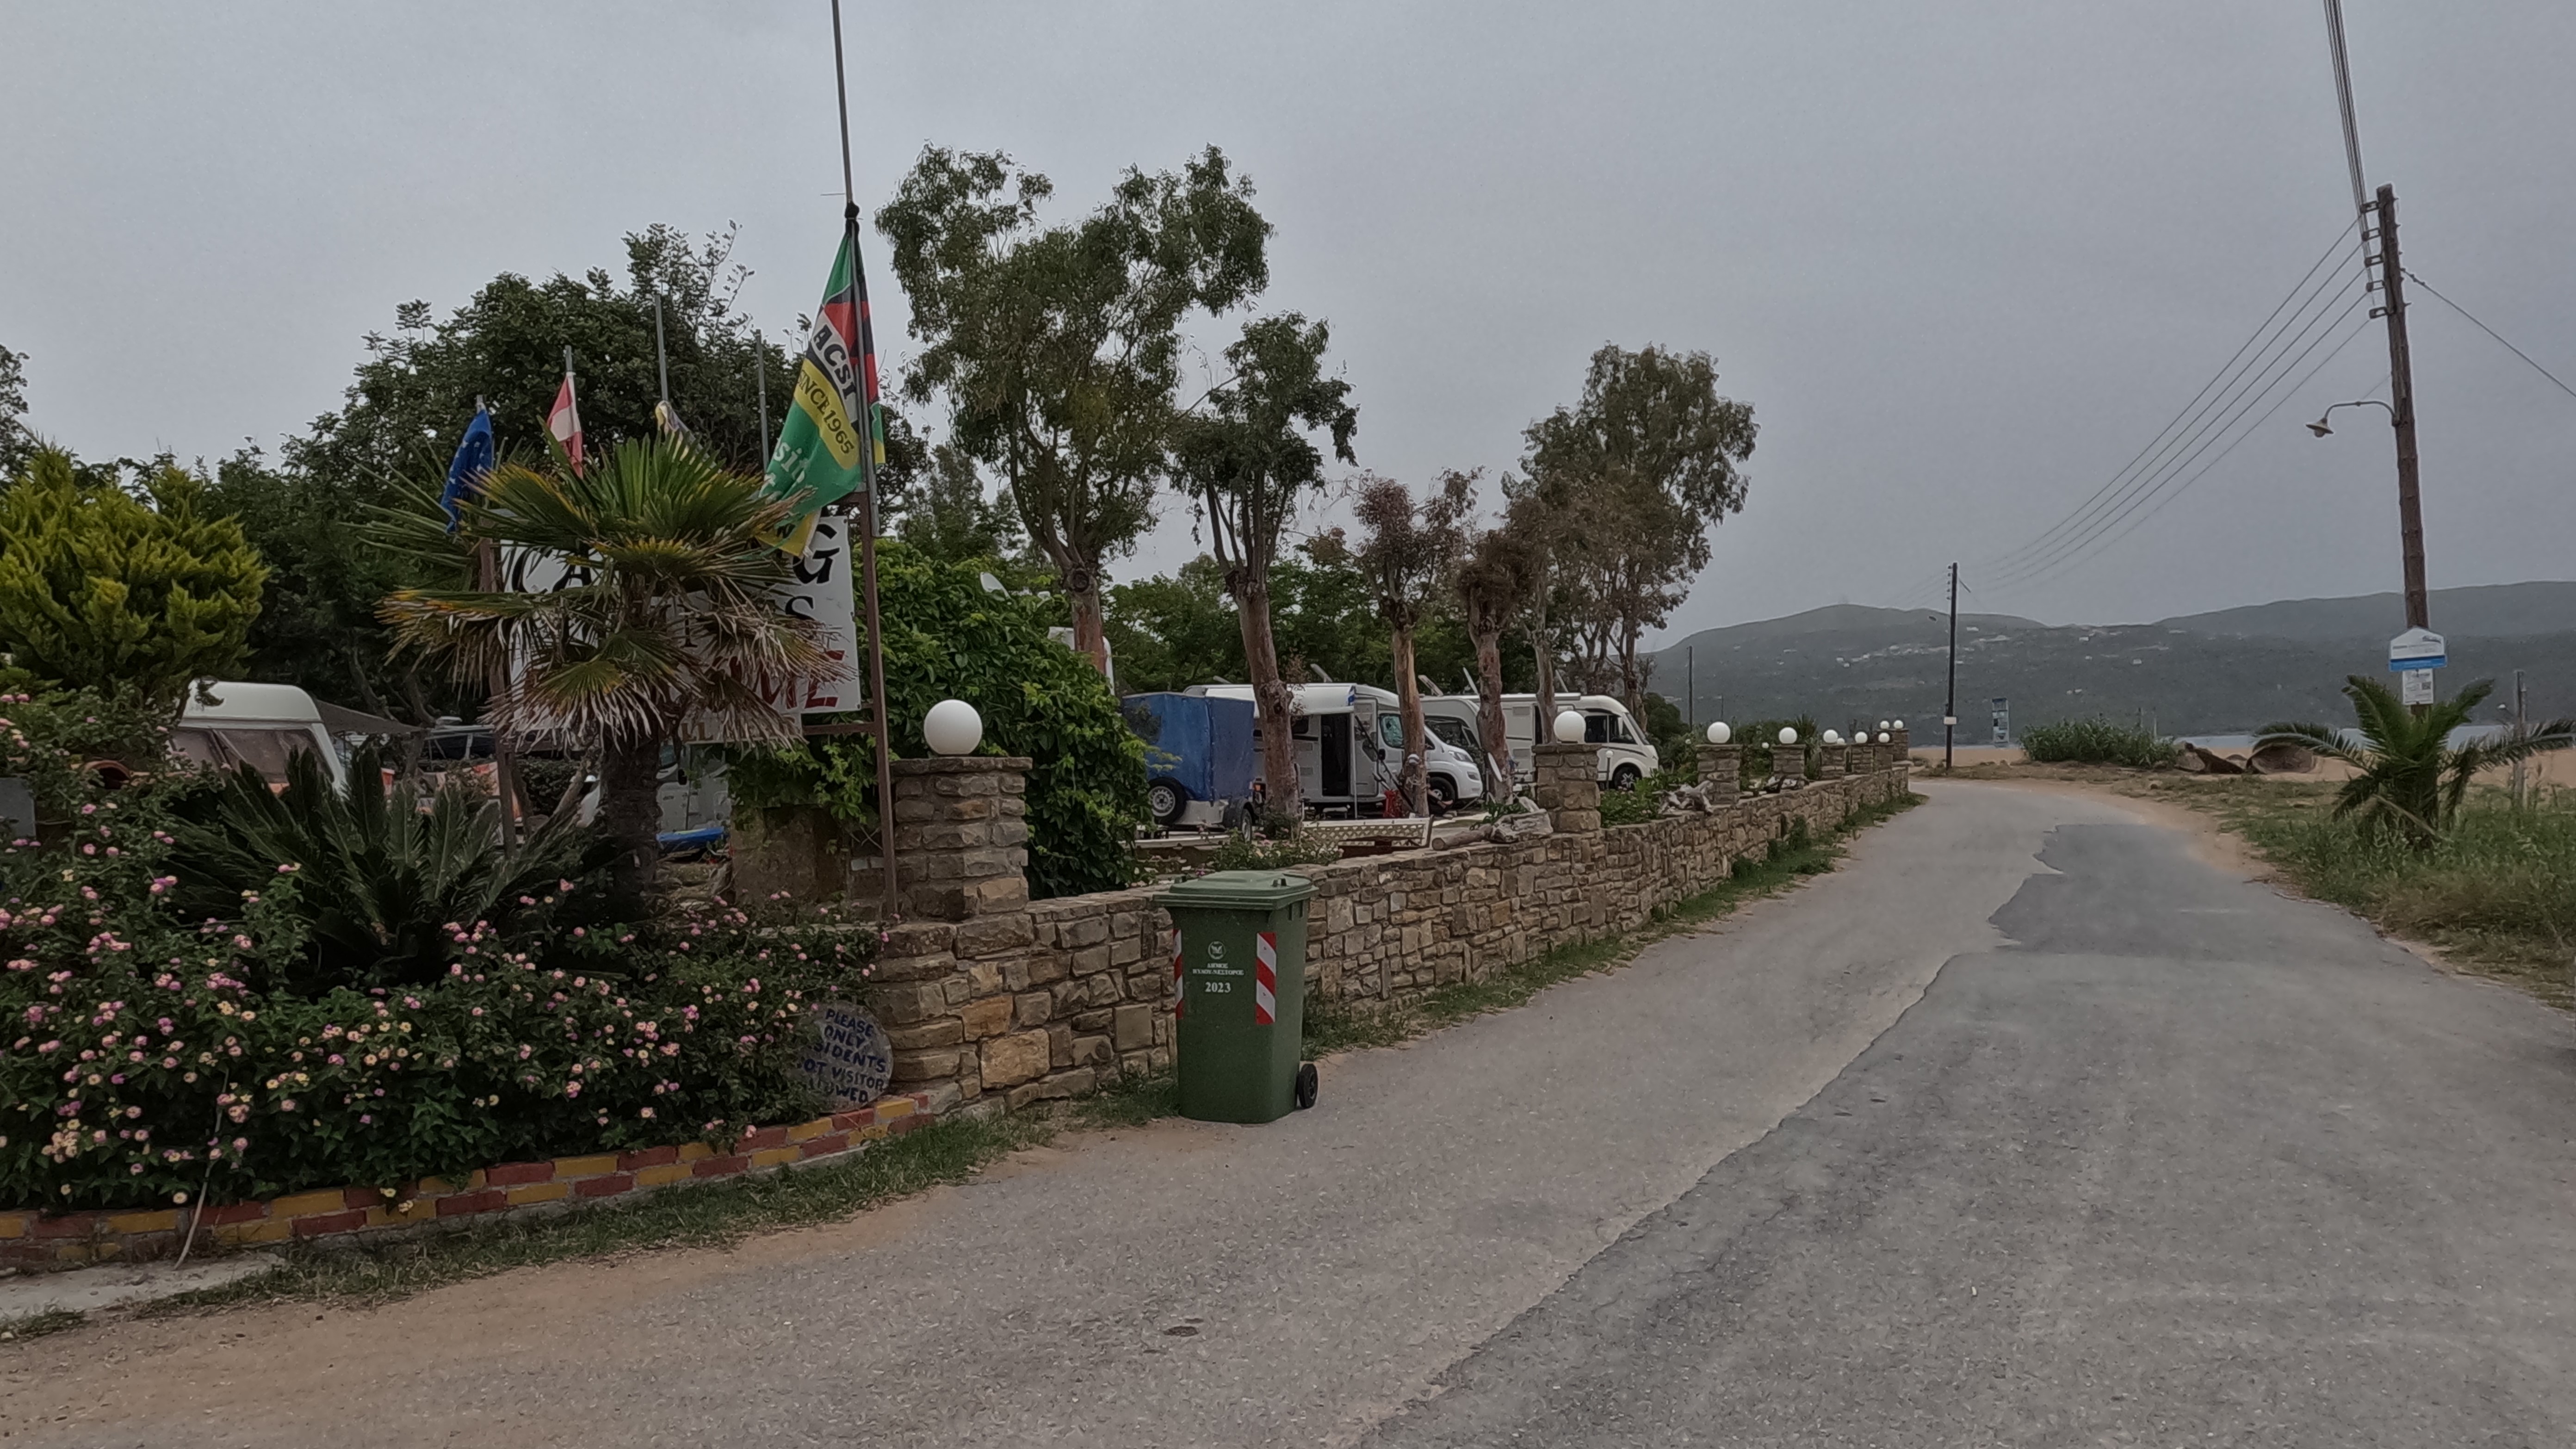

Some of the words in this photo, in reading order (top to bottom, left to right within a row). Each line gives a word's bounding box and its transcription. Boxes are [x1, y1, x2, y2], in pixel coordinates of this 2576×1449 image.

[813, 324, 856, 400] ACSI
[824, 409, 855, 454] 1965
[1205, 981, 1231, 993] 2023
[824, 1025, 865, 1048] ONLY
[825, 1009, 873, 1037] PLEASE
[813, 1042, 886, 1073] SIDENTS
[803, 1059, 827, 1074] OT
[832, 1067, 884, 1092] VISITOR
